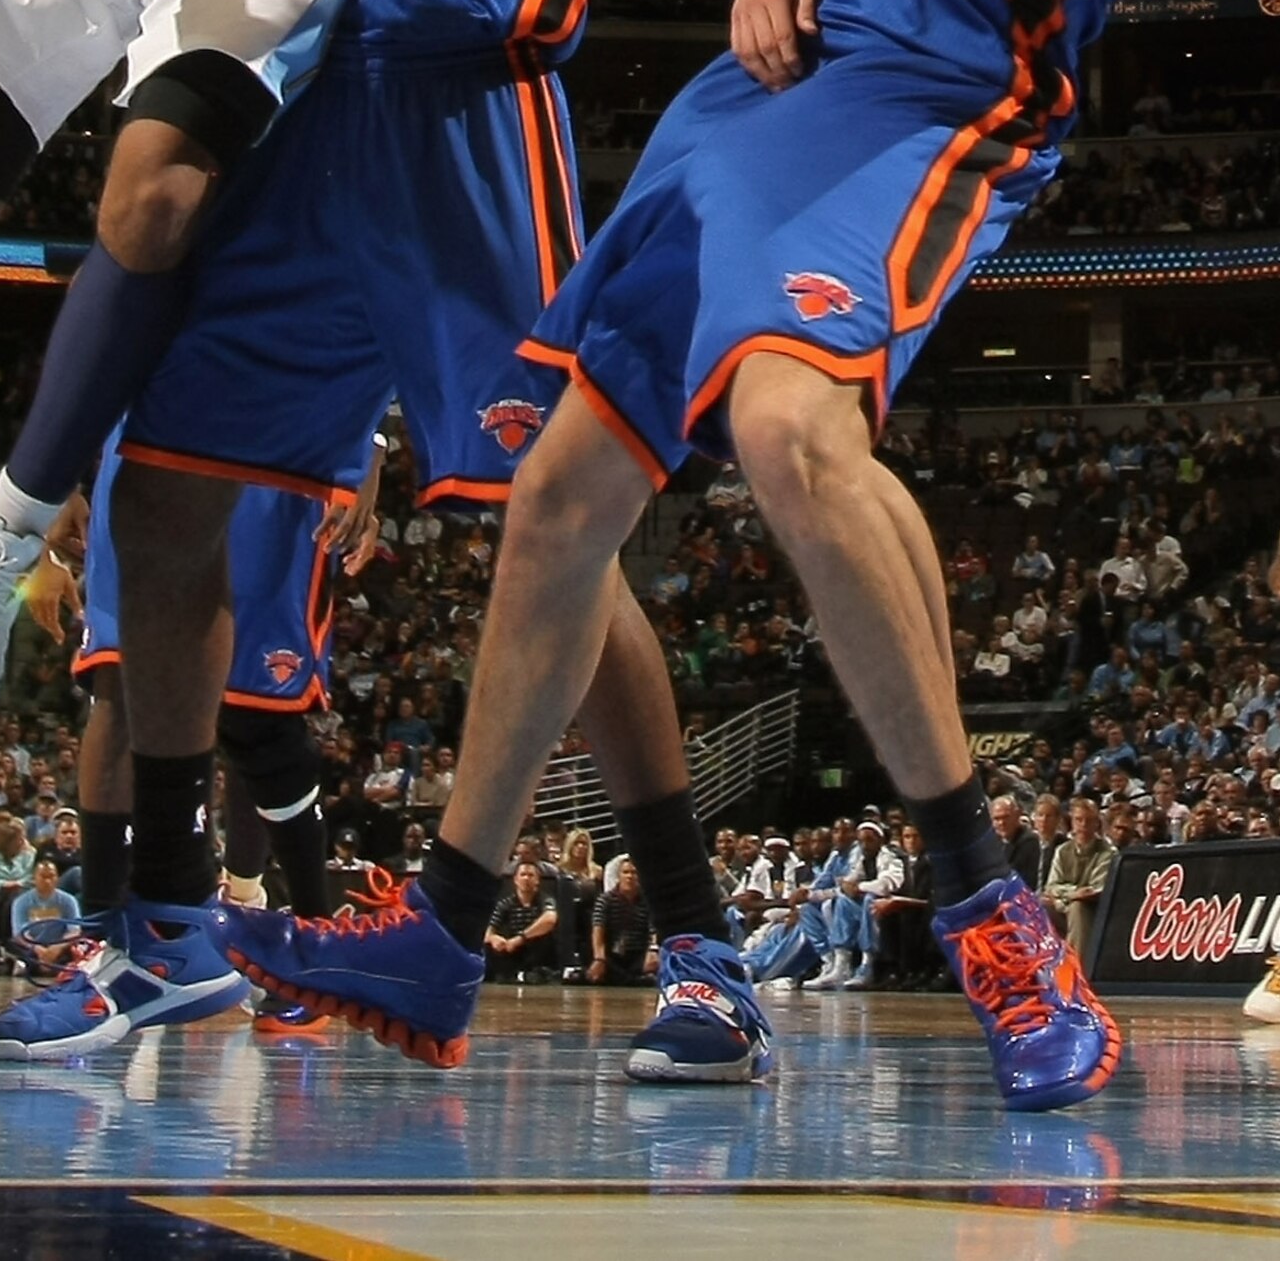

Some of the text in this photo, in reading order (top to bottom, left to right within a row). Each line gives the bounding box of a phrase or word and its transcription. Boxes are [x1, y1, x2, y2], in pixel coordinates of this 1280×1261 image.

[969, 731, 1034, 758] IGHT
[1129, 863, 1237, 964] Coors
[670, 983, 721, 1002] NIKE
